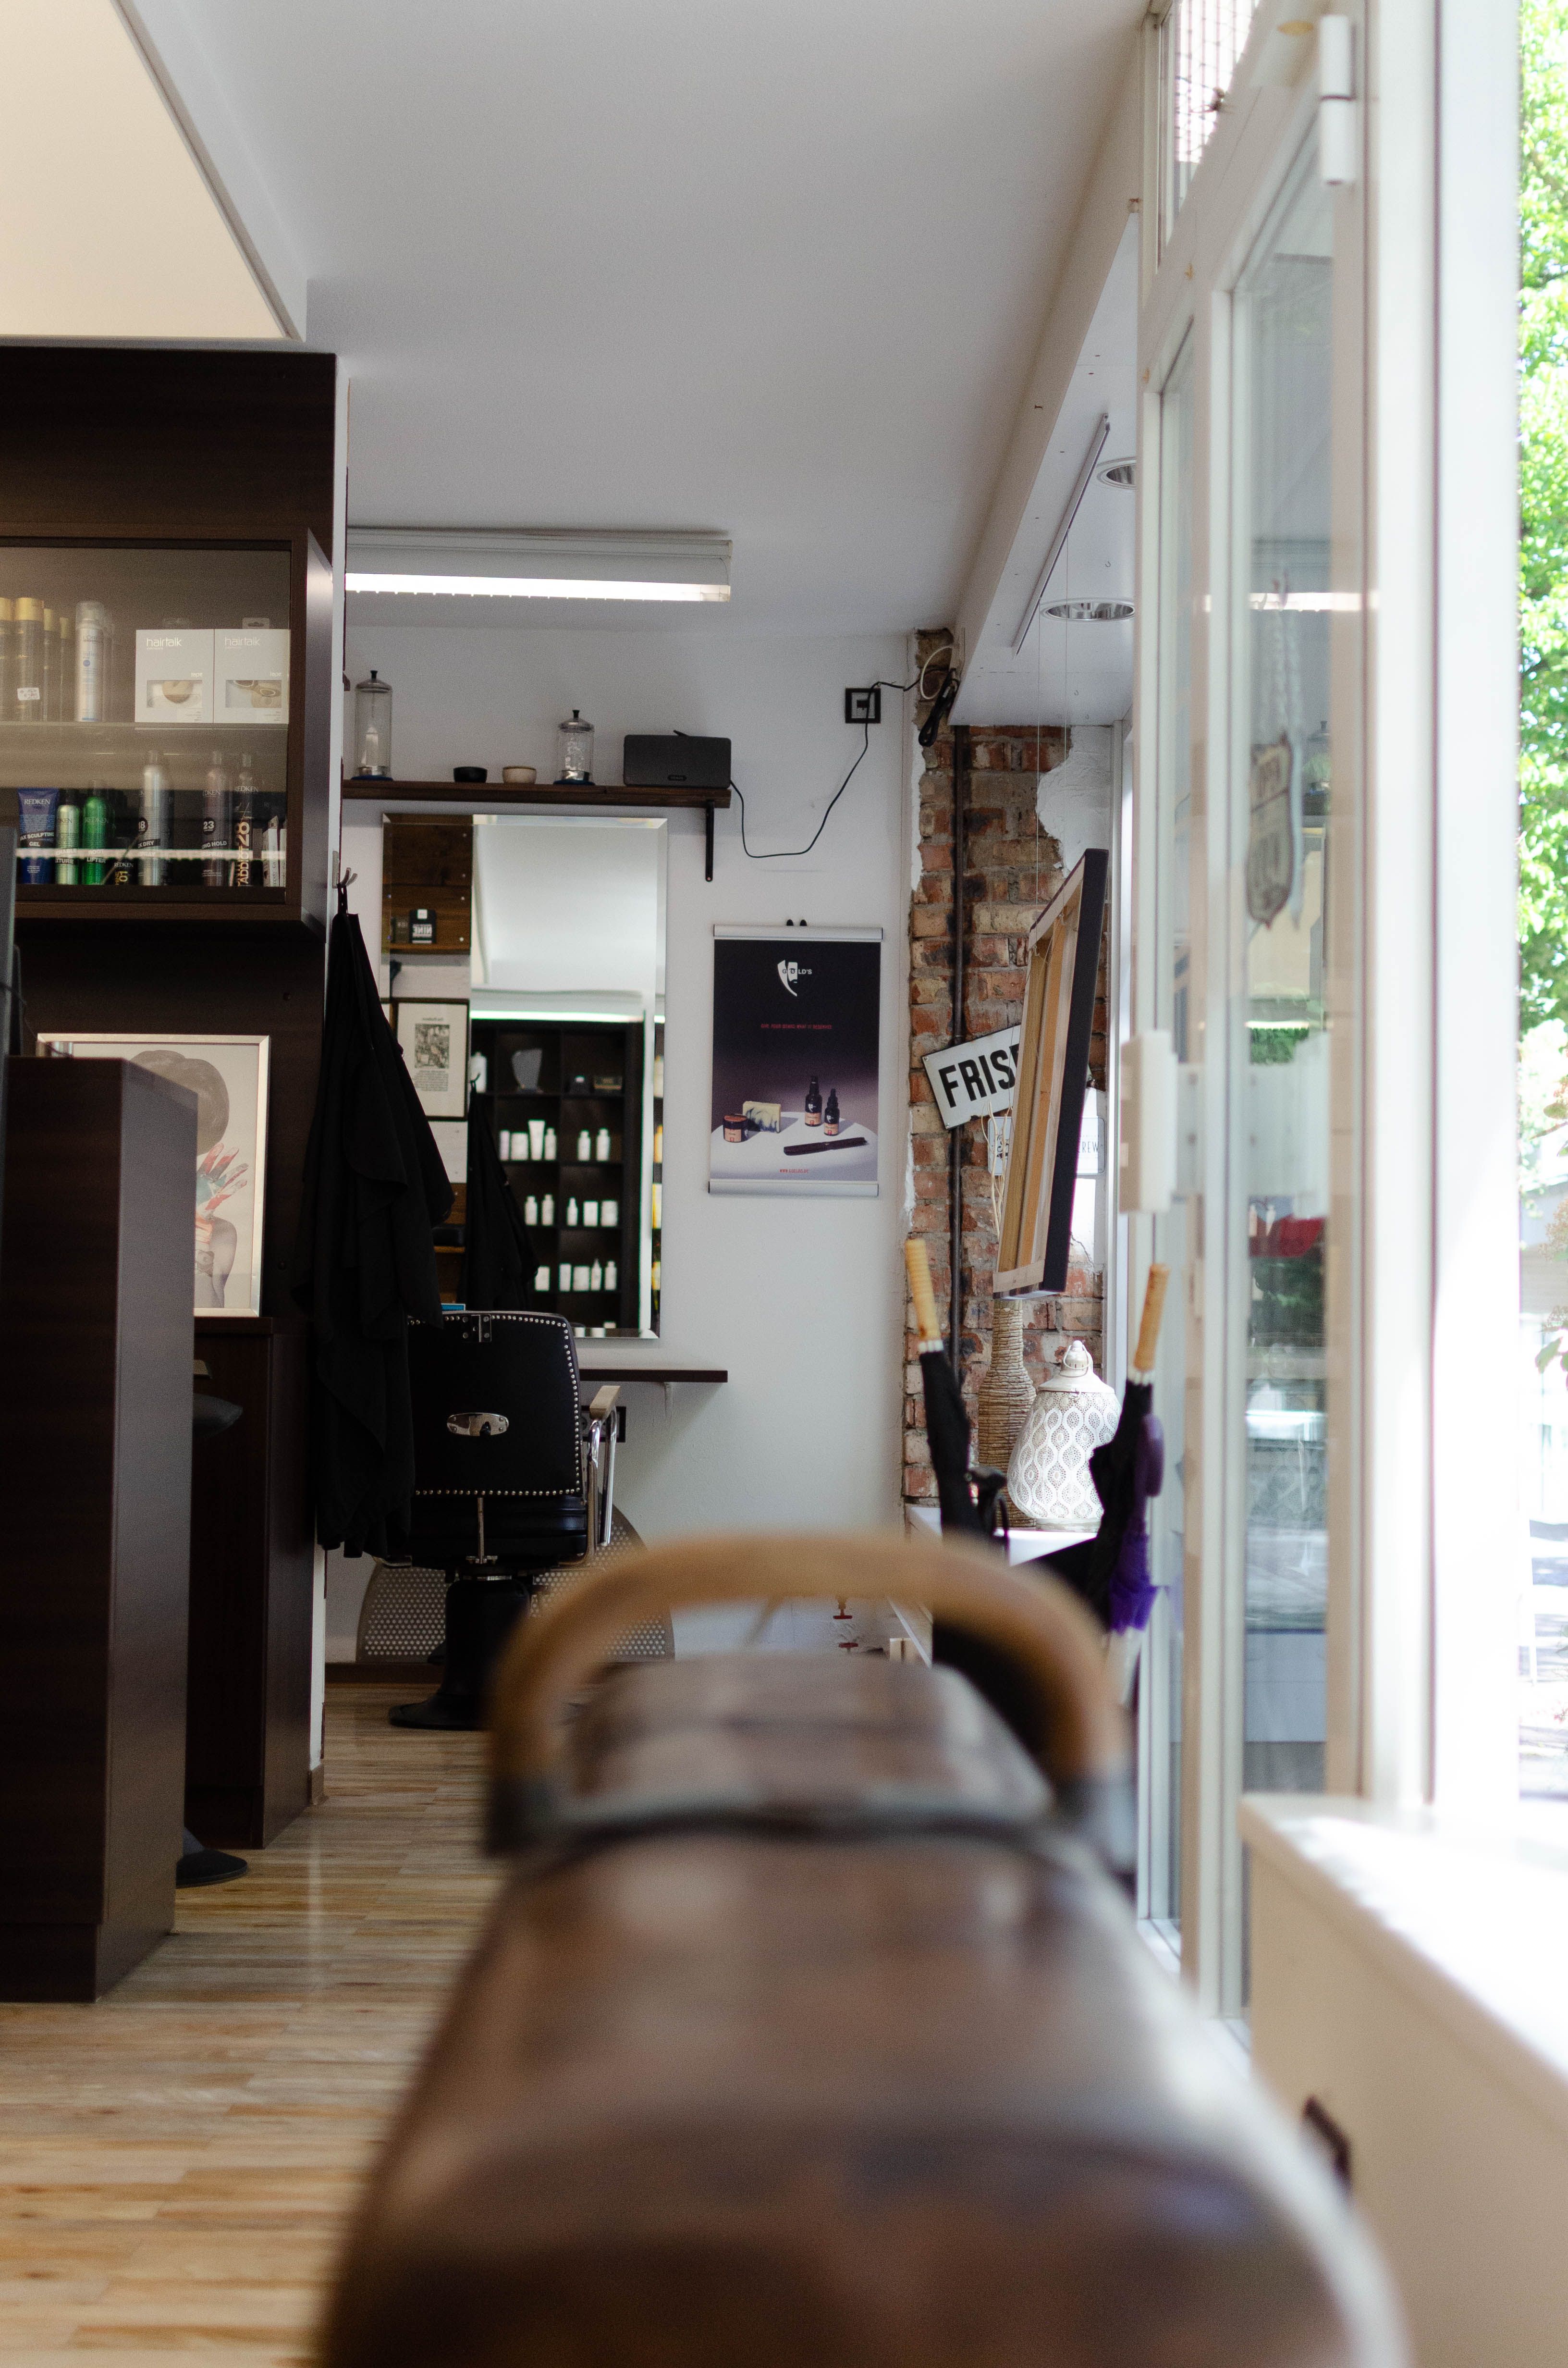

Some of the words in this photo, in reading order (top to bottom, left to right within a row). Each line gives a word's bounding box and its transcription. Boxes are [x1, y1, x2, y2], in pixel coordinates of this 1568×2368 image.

[147, 637, 182, 647] hairtalk
[225, 636, 261, 646] hairtalk
[203, 820, 214, 829] 23
[235, 821, 250, 846] 28
[1078, 1142, 1099, 1153] REW
